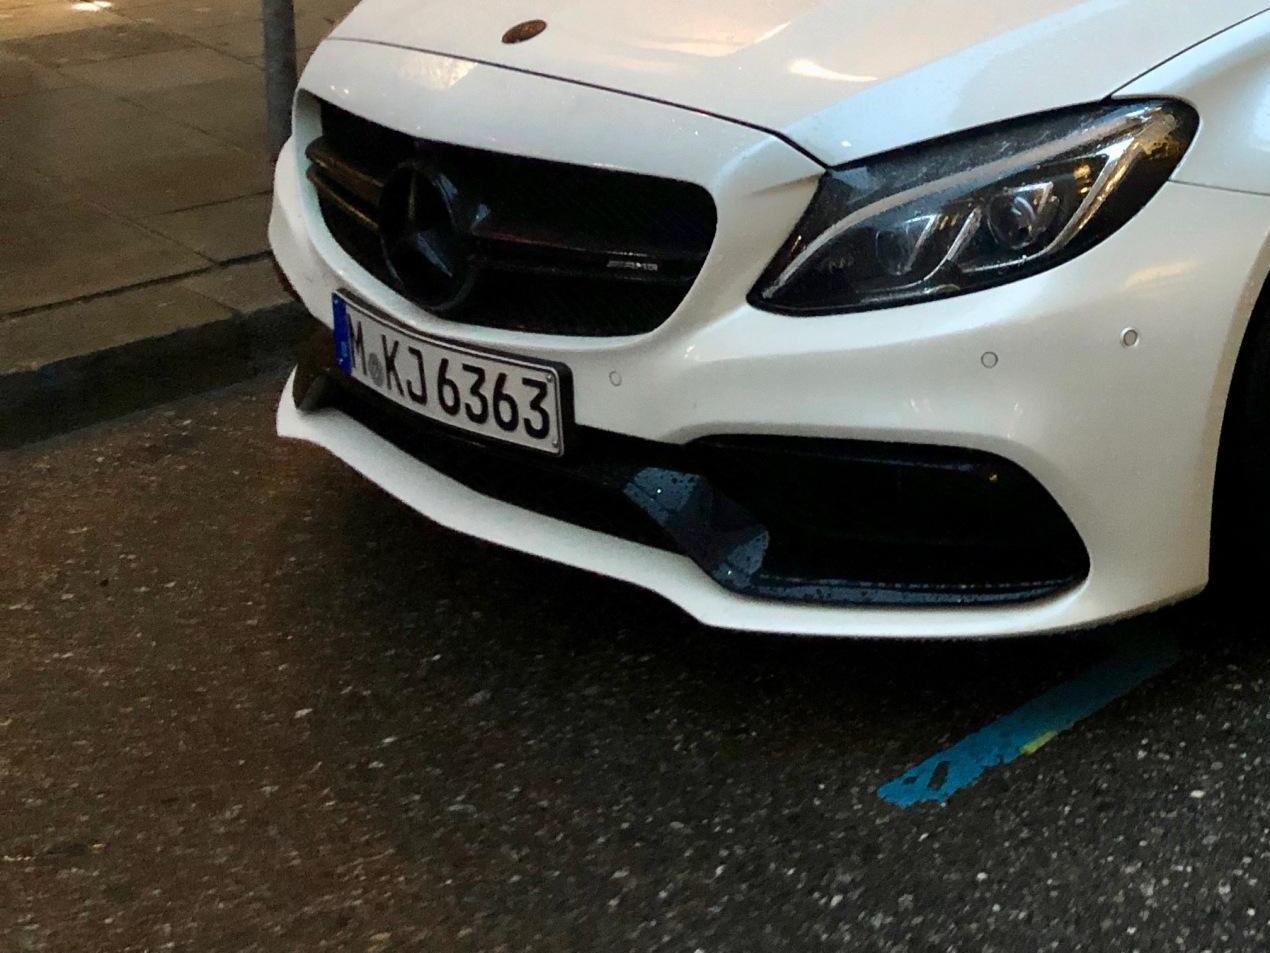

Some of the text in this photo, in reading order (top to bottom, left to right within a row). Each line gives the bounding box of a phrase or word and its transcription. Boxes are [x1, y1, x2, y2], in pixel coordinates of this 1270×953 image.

[345, 312, 550, 440] M KJ 6363
